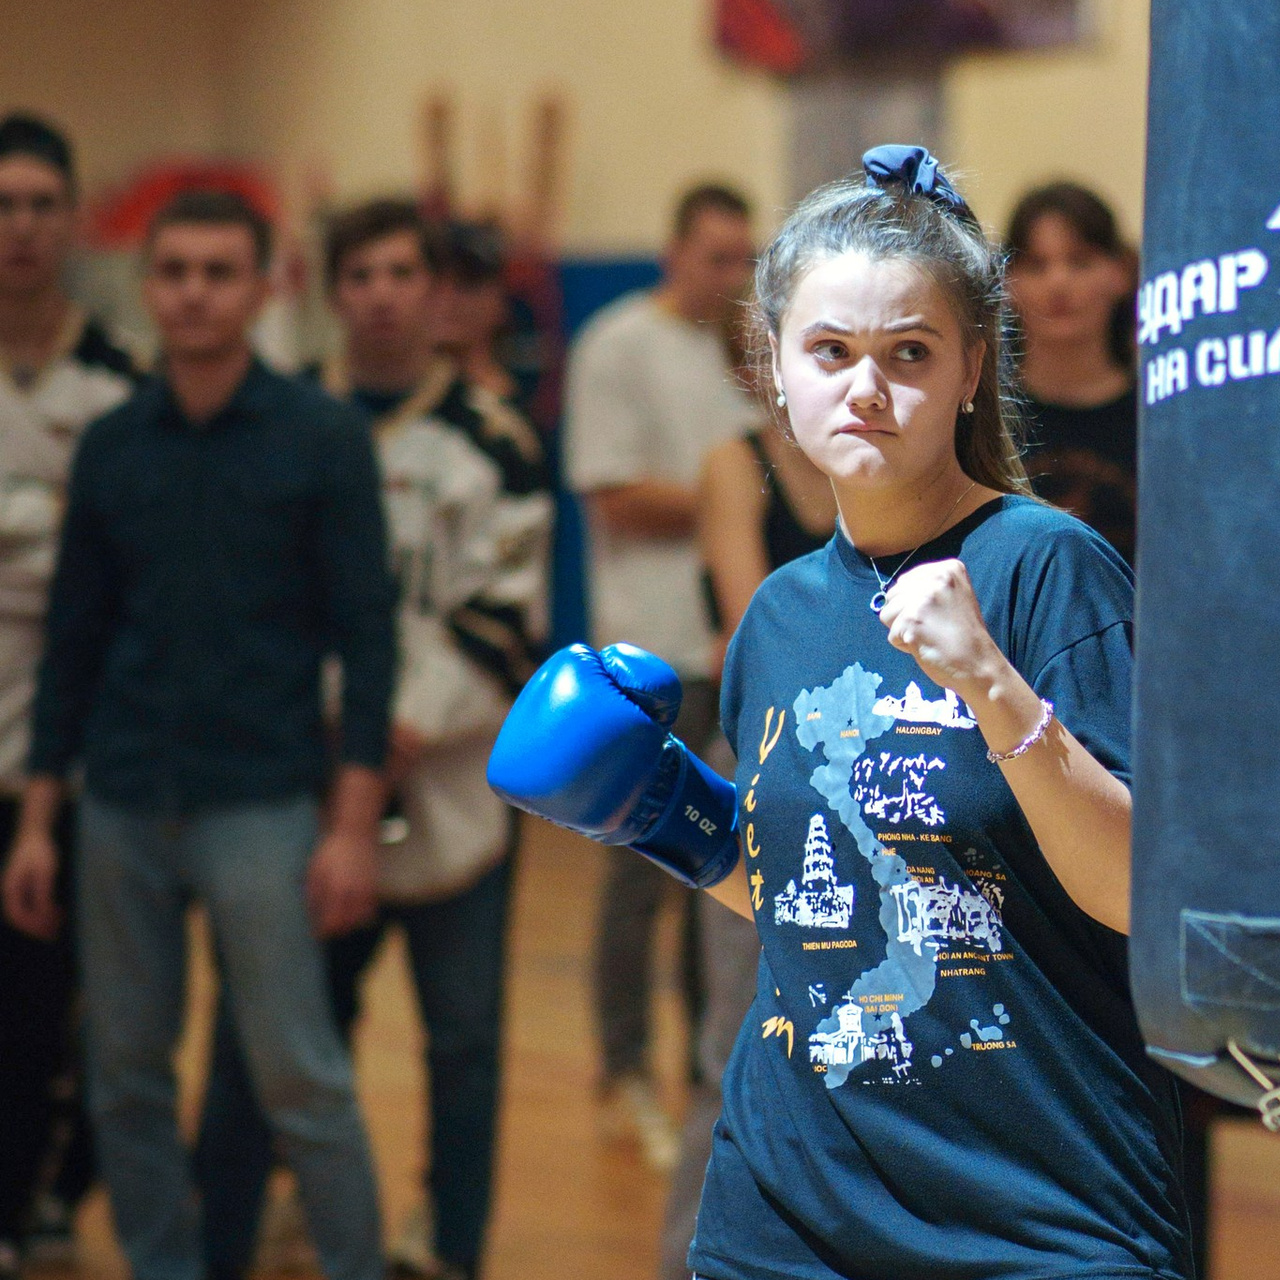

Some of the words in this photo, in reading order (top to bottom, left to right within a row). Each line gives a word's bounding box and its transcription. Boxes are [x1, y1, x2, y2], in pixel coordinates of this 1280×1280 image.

[1146, 347, 1188, 406] НА
[896, 726, 942, 736] HALONGBAY
[685, 805, 700, 821] 10
[699, 818, 717, 836] OZ
[878, 833, 900, 841] PHONG
[901, 833, 915, 841] NHA
[920, 833, 930, 841] KE
[917, 866, 935, 874] NANG
[802, 942, 821, 950] THIEN
[822, 941, 831, 949] MU
[832, 940, 857, 949] PAGODA
[992, 953, 1013, 961] TOWN
[940, 968, 985, 977] NHATRANG
[859, 995, 868, 1003] HO
[869, 995, 883, 1003] CHI
[884, 993, 904, 1002] MINH
[972, 1042, 1004, 1051] TRUONG
[1006, 1041, 1016, 1049] SA
